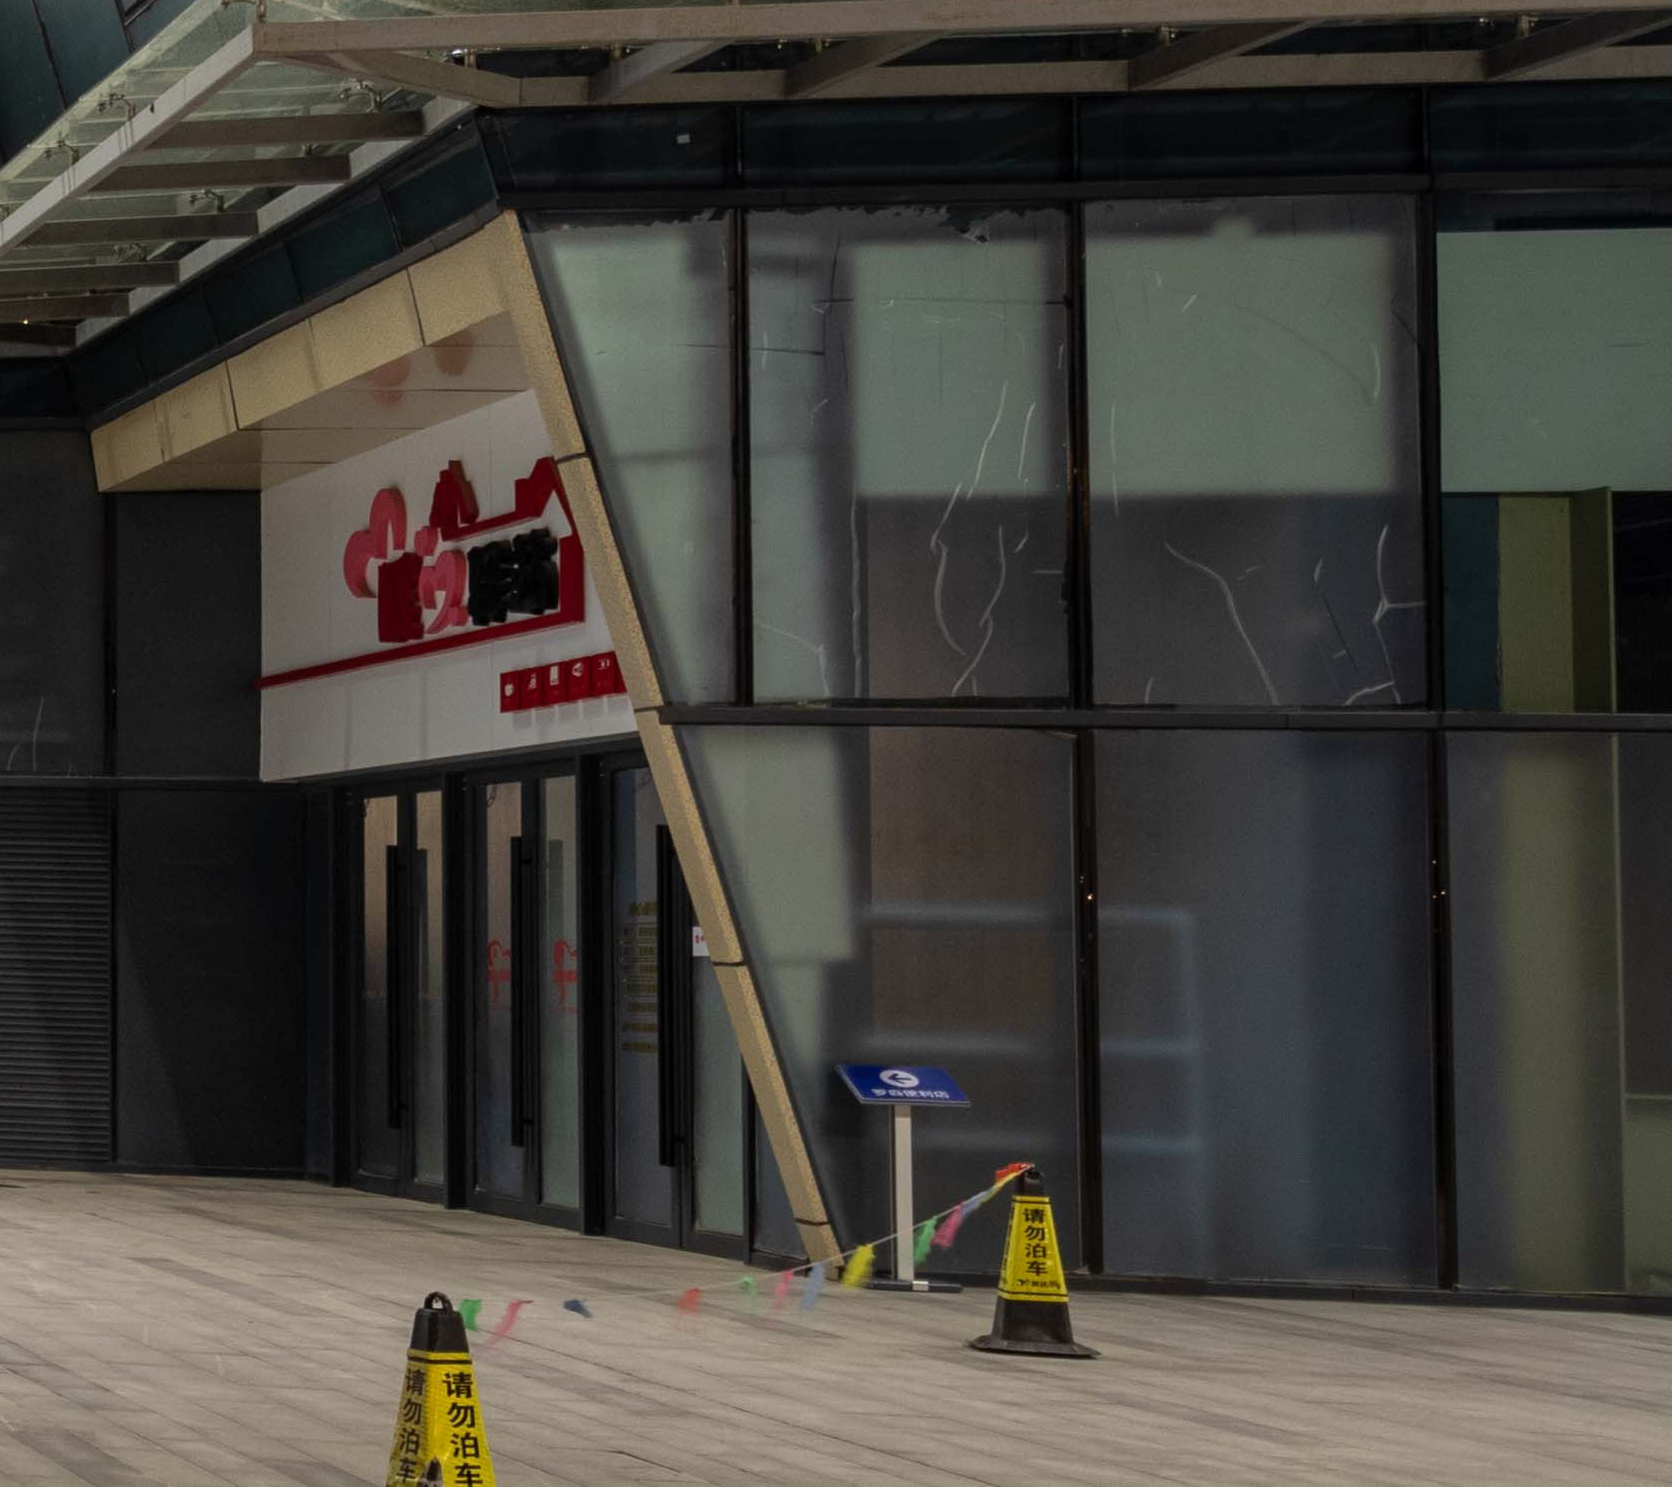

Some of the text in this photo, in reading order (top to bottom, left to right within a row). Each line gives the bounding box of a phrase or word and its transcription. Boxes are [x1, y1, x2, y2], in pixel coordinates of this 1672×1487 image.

[1023, 1209, 1048, 1276] 请勿泊车
[397, 1369, 426, 1483] 请勿泊车
[442, 1372, 484, 1487] 请勿泊车
